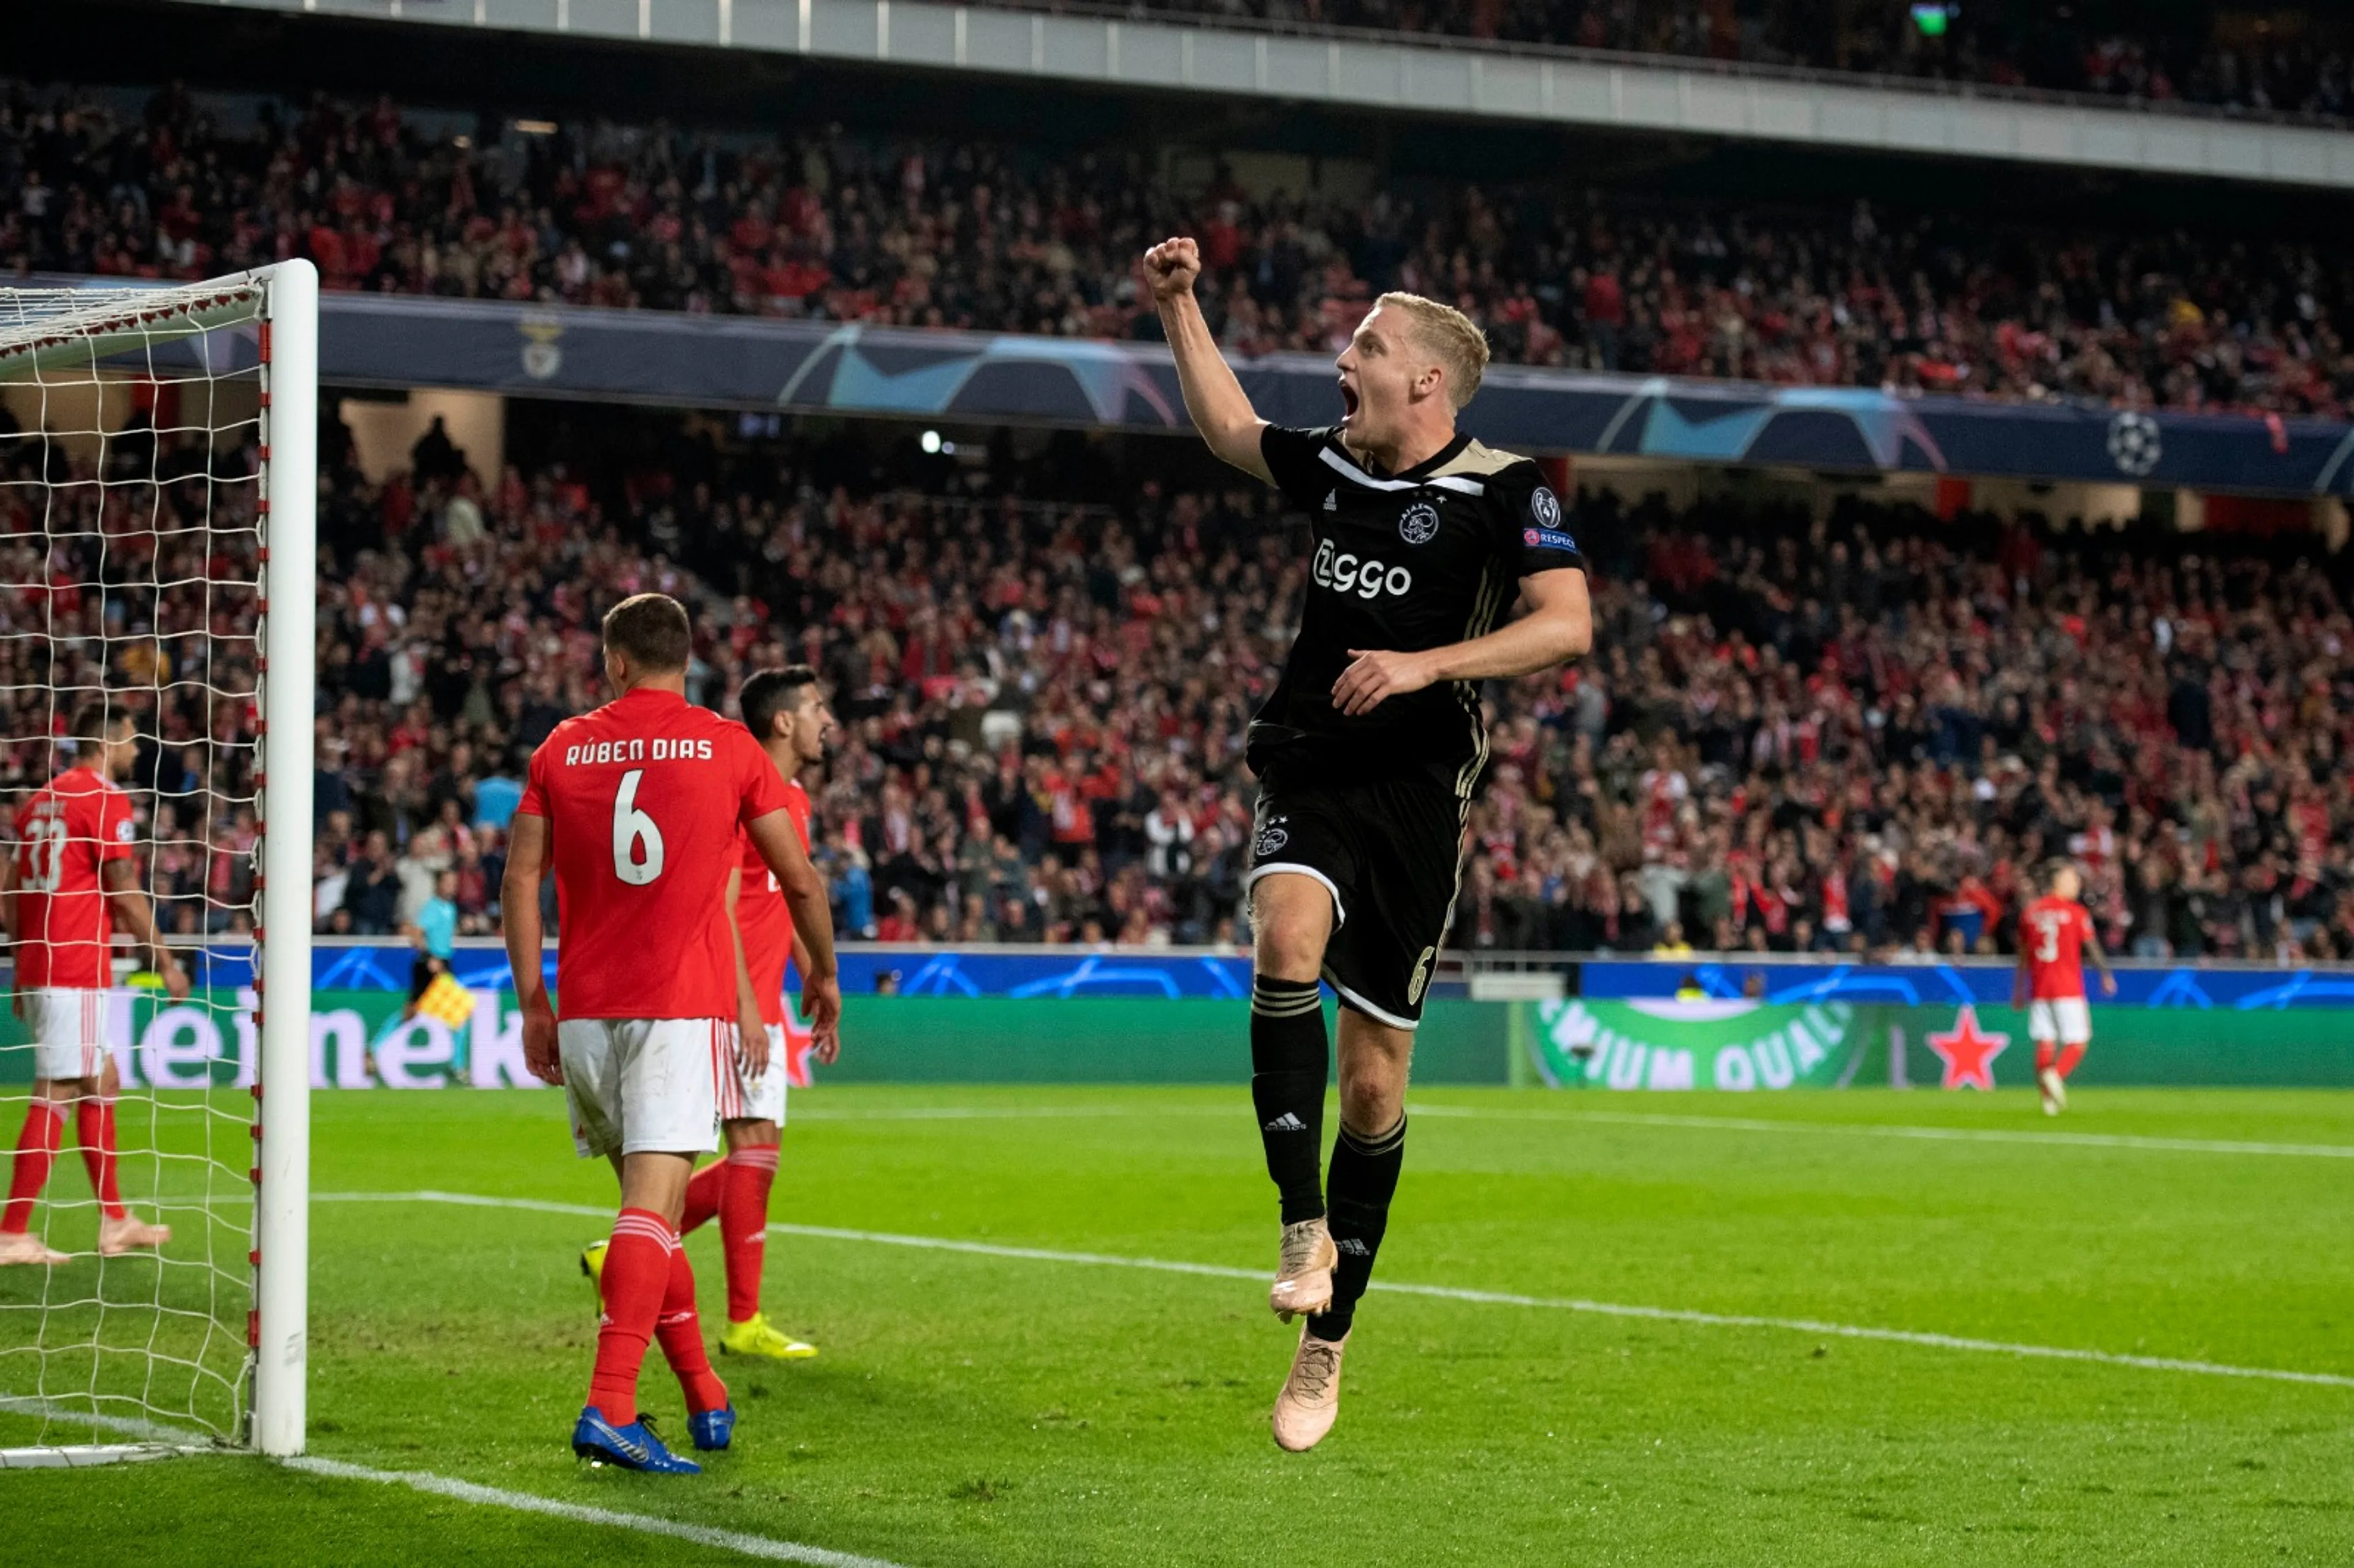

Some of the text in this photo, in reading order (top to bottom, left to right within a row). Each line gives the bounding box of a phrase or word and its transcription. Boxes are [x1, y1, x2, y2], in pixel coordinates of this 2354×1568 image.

[1312, 537, 1412, 599] Zggo
[565, 737, 713, 766] RÚBEN DIAS
[612, 769, 665, 886] 6
[2035, 922, 2060, 963] 3
[1407, 945, 1436, 1006] 6
[109, 986, 547, 1089] einek
